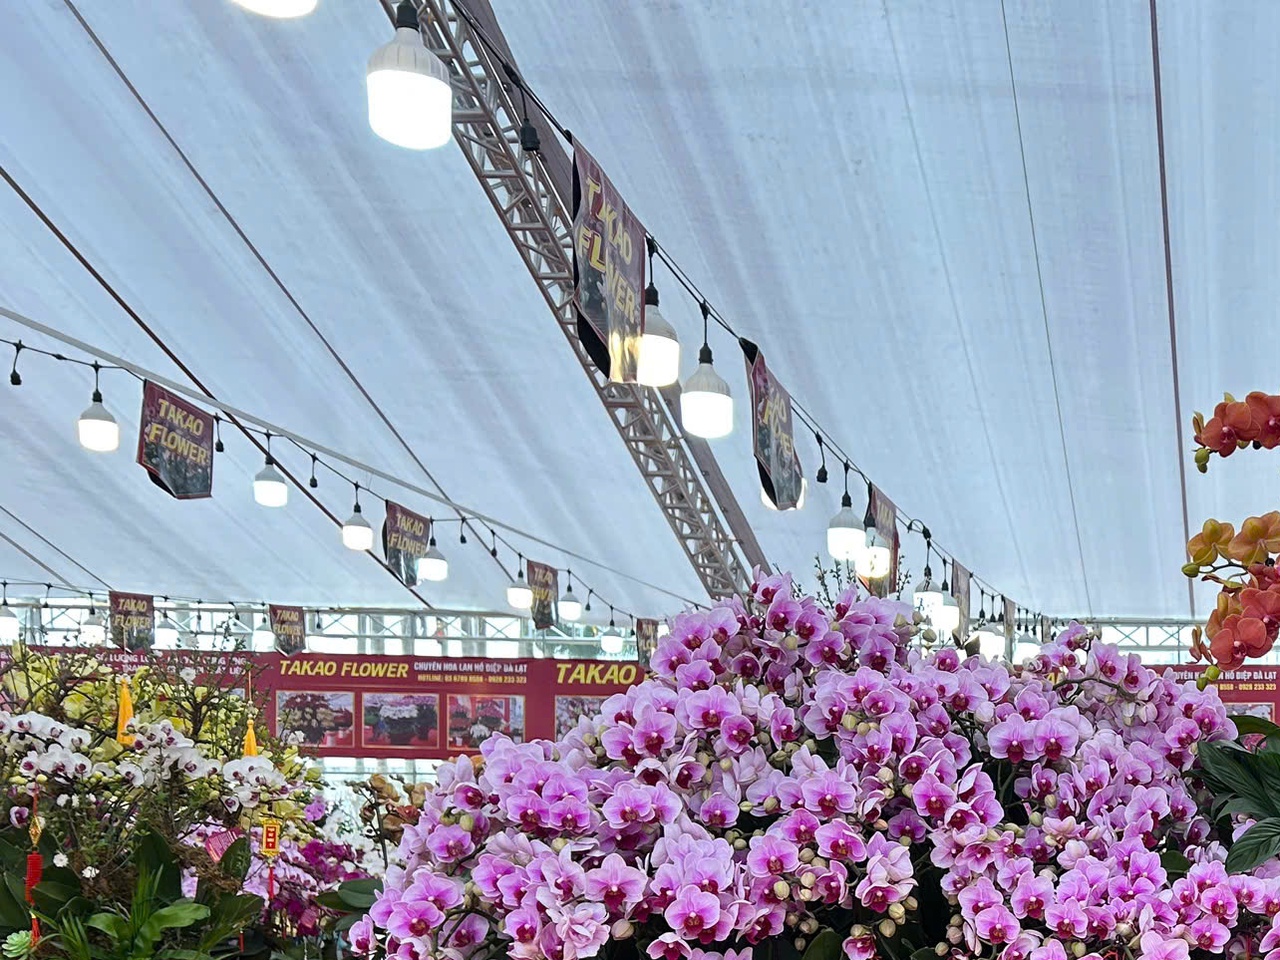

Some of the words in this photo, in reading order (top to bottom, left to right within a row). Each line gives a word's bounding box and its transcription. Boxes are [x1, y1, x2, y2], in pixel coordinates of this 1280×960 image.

[158, 398, 204, 436] TAKAO
[149, 423, 207, 464] FLOWER
[396, 513, 424, 536] TAKAO
[118, 598, 147, 612] TAKAO
[280, 660, 337, 676] TAKAO
[341, 662, 409, 678] FLOWER
[557, 663, 637, 685] TAKAO
